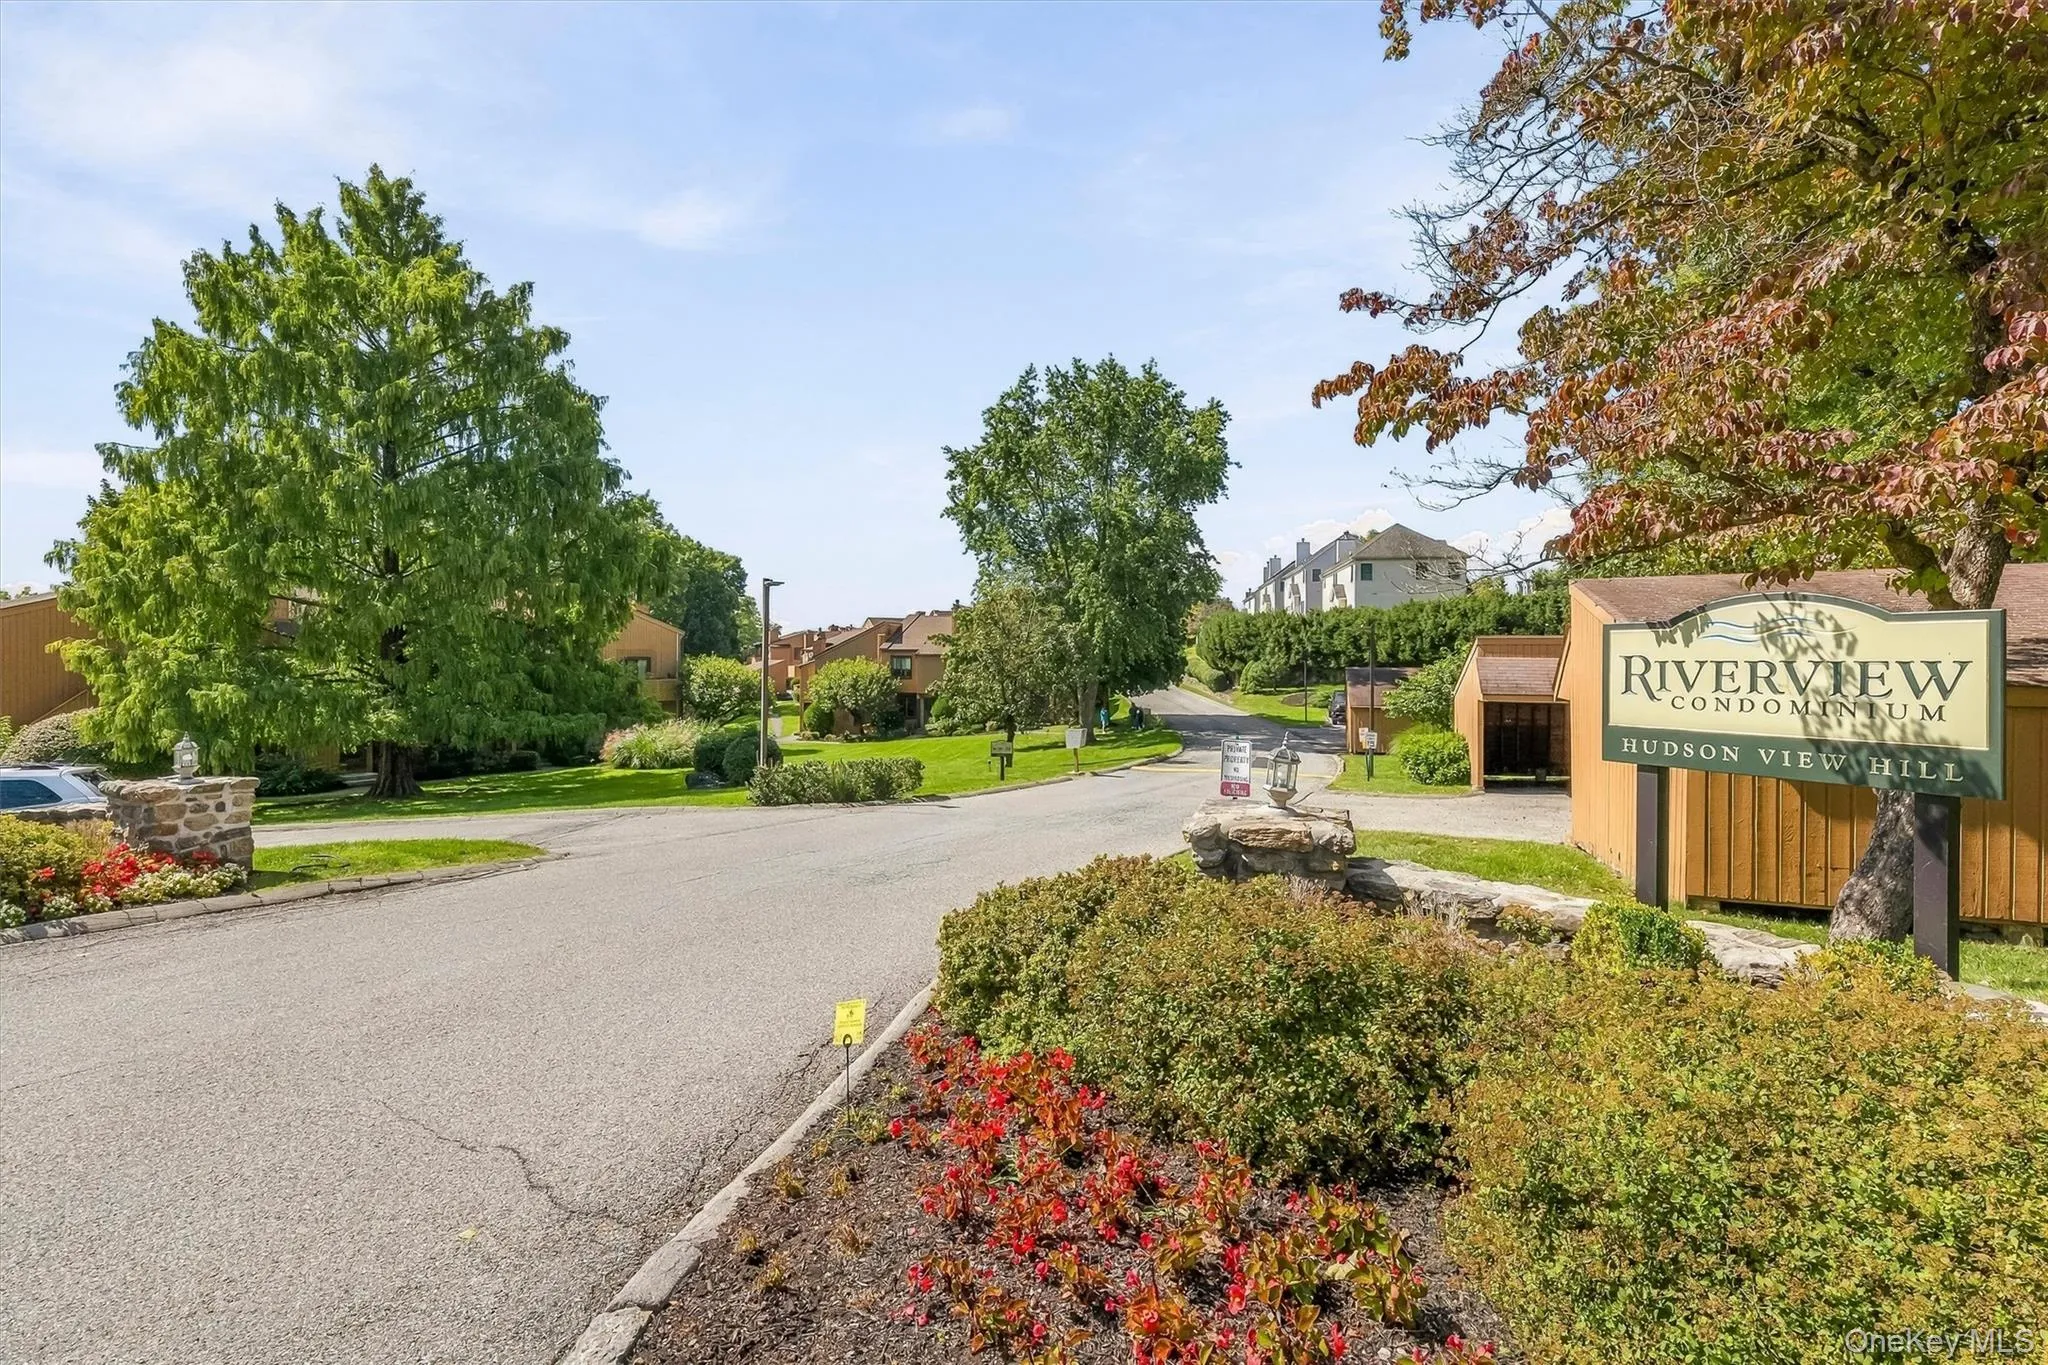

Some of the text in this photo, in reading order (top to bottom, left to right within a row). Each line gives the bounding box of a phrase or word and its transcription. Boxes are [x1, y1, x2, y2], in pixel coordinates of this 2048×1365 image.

[1619, 655, 1973, 701] RIVERVIEW
[1671, 696, 1946, 722] CONDOMINIUM
[1224, 755, 1249, 764] PROPERTY
[1226, 745, 1247, 754] PRIVATE
[1622, 738, 1964, 782] HUDSON VIEW HILL
